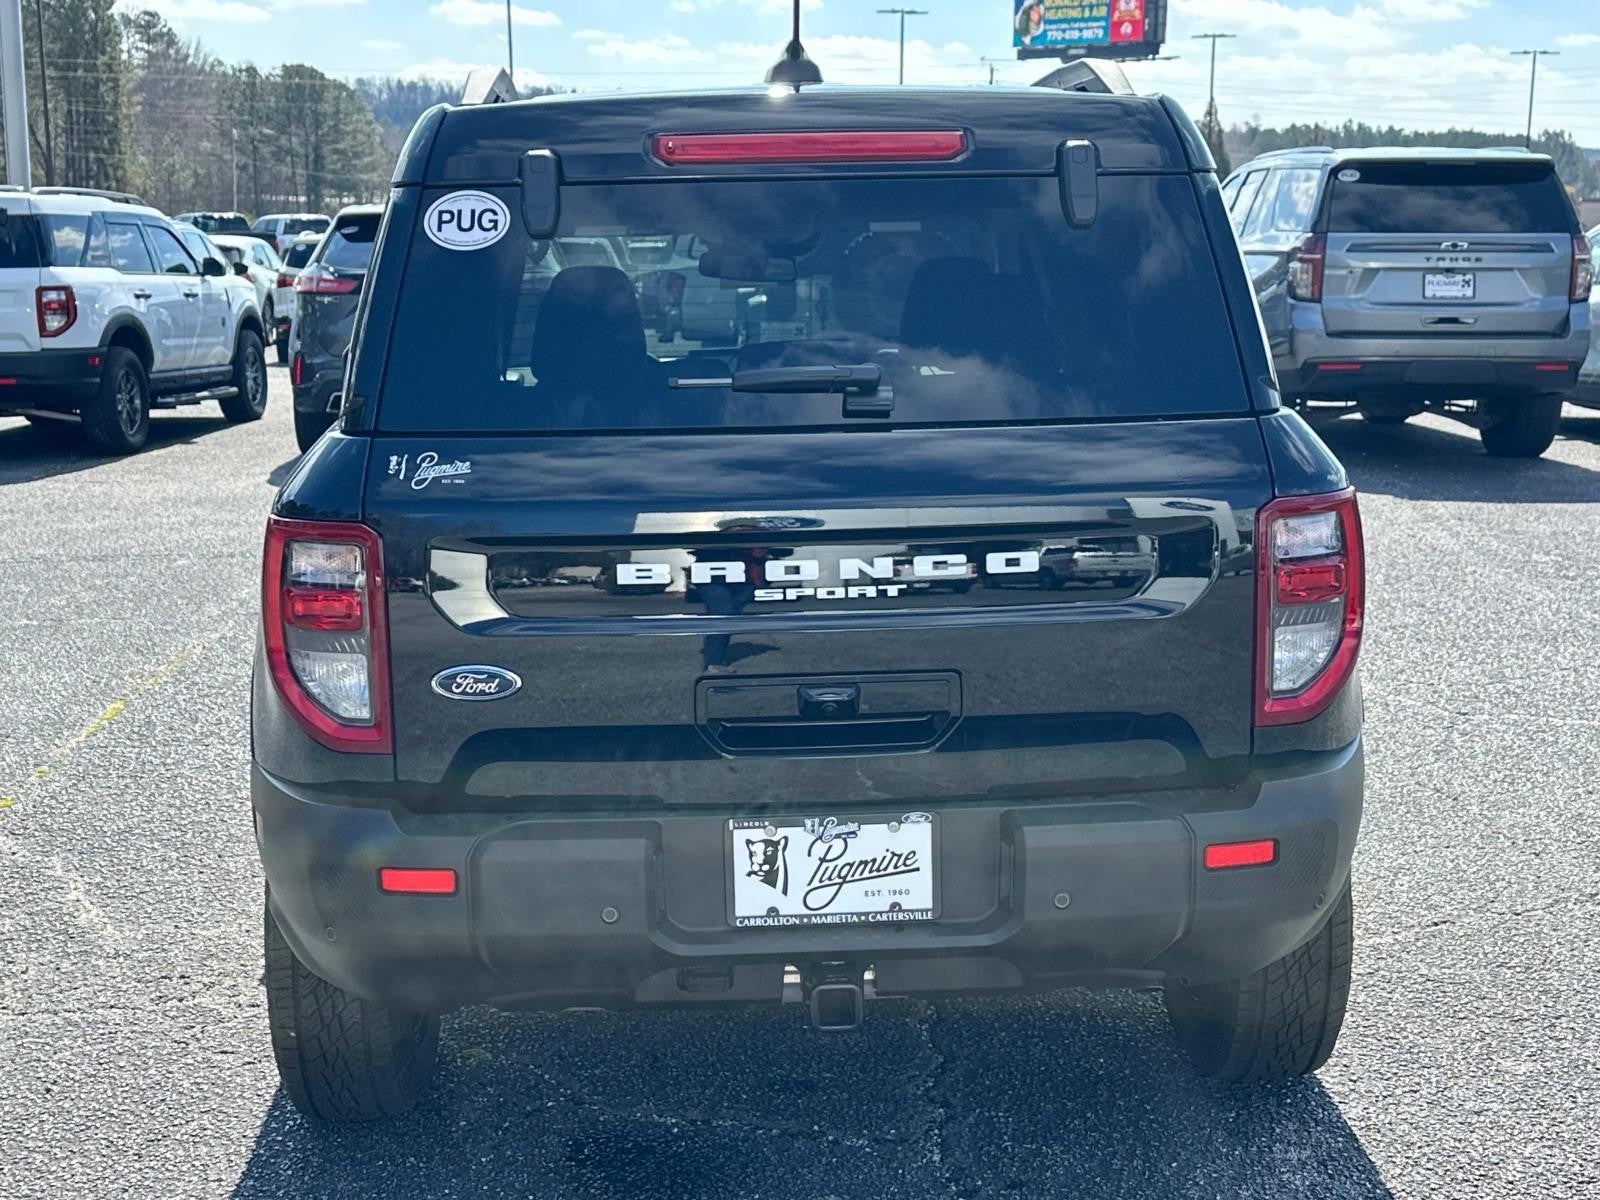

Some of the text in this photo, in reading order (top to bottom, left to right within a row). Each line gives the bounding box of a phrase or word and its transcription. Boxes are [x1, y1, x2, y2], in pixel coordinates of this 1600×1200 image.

[1091, 6, 1108, 17] AIR
[437, 208, 499, 232] PUG
[411, 451, 472, 490] Pugmire
[616, 551, 1040, 584] BRONCO
[753, 584, 908, 601] SPORT
[451, 673, 500, 693] Ford
[803, 836, 920, 911] Pugmire
[864, 888, 911, 897] EST. 1960
[736, 911, 934, 927] CARROLLTON MARIETTA CARTERSVILLE
